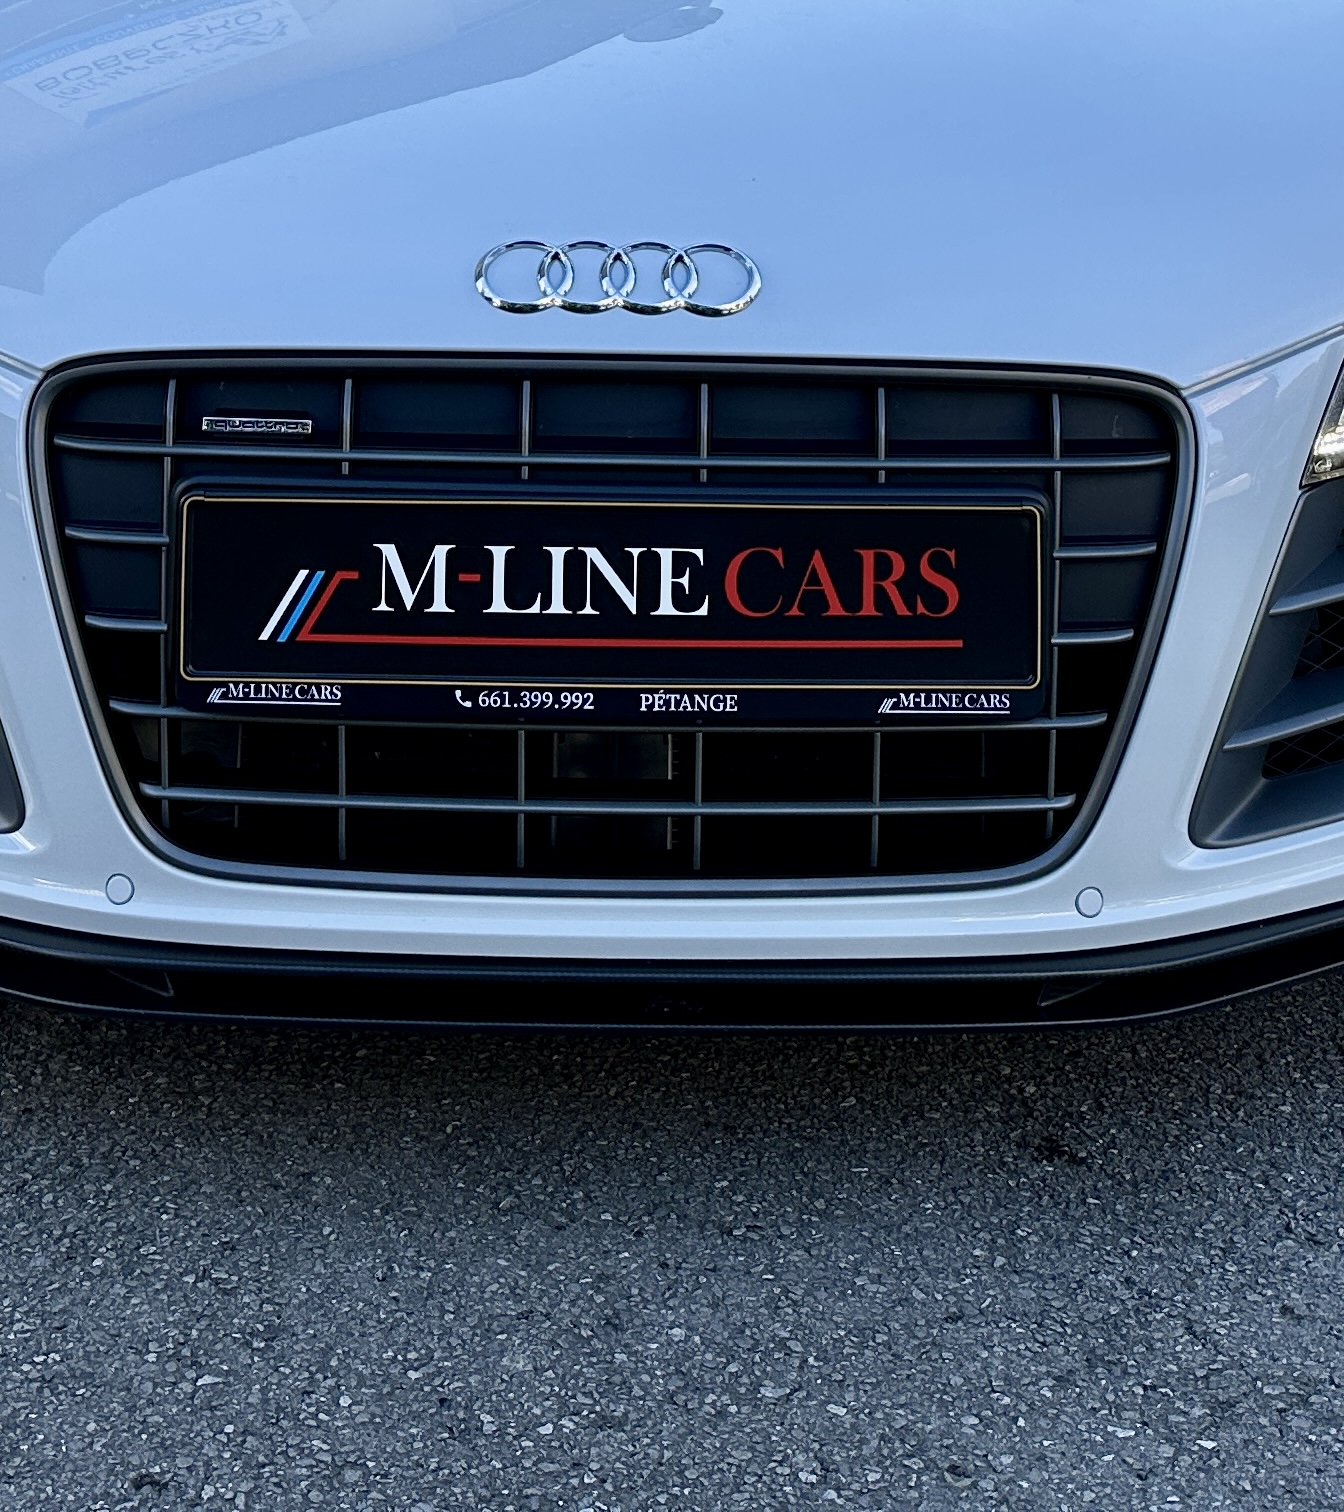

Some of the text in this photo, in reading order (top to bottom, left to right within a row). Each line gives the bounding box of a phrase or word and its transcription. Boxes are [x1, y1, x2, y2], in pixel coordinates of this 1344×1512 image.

[372, 543, 959, 619] M-LINE CARS
[228, 683, 342, 700] M-LINE CARS
[478, 691, 595, 710] 661.399.992
[639, 690, 739, 712] PÉTANGE
[899, 693, 1010, 709] M-LINE CARS
